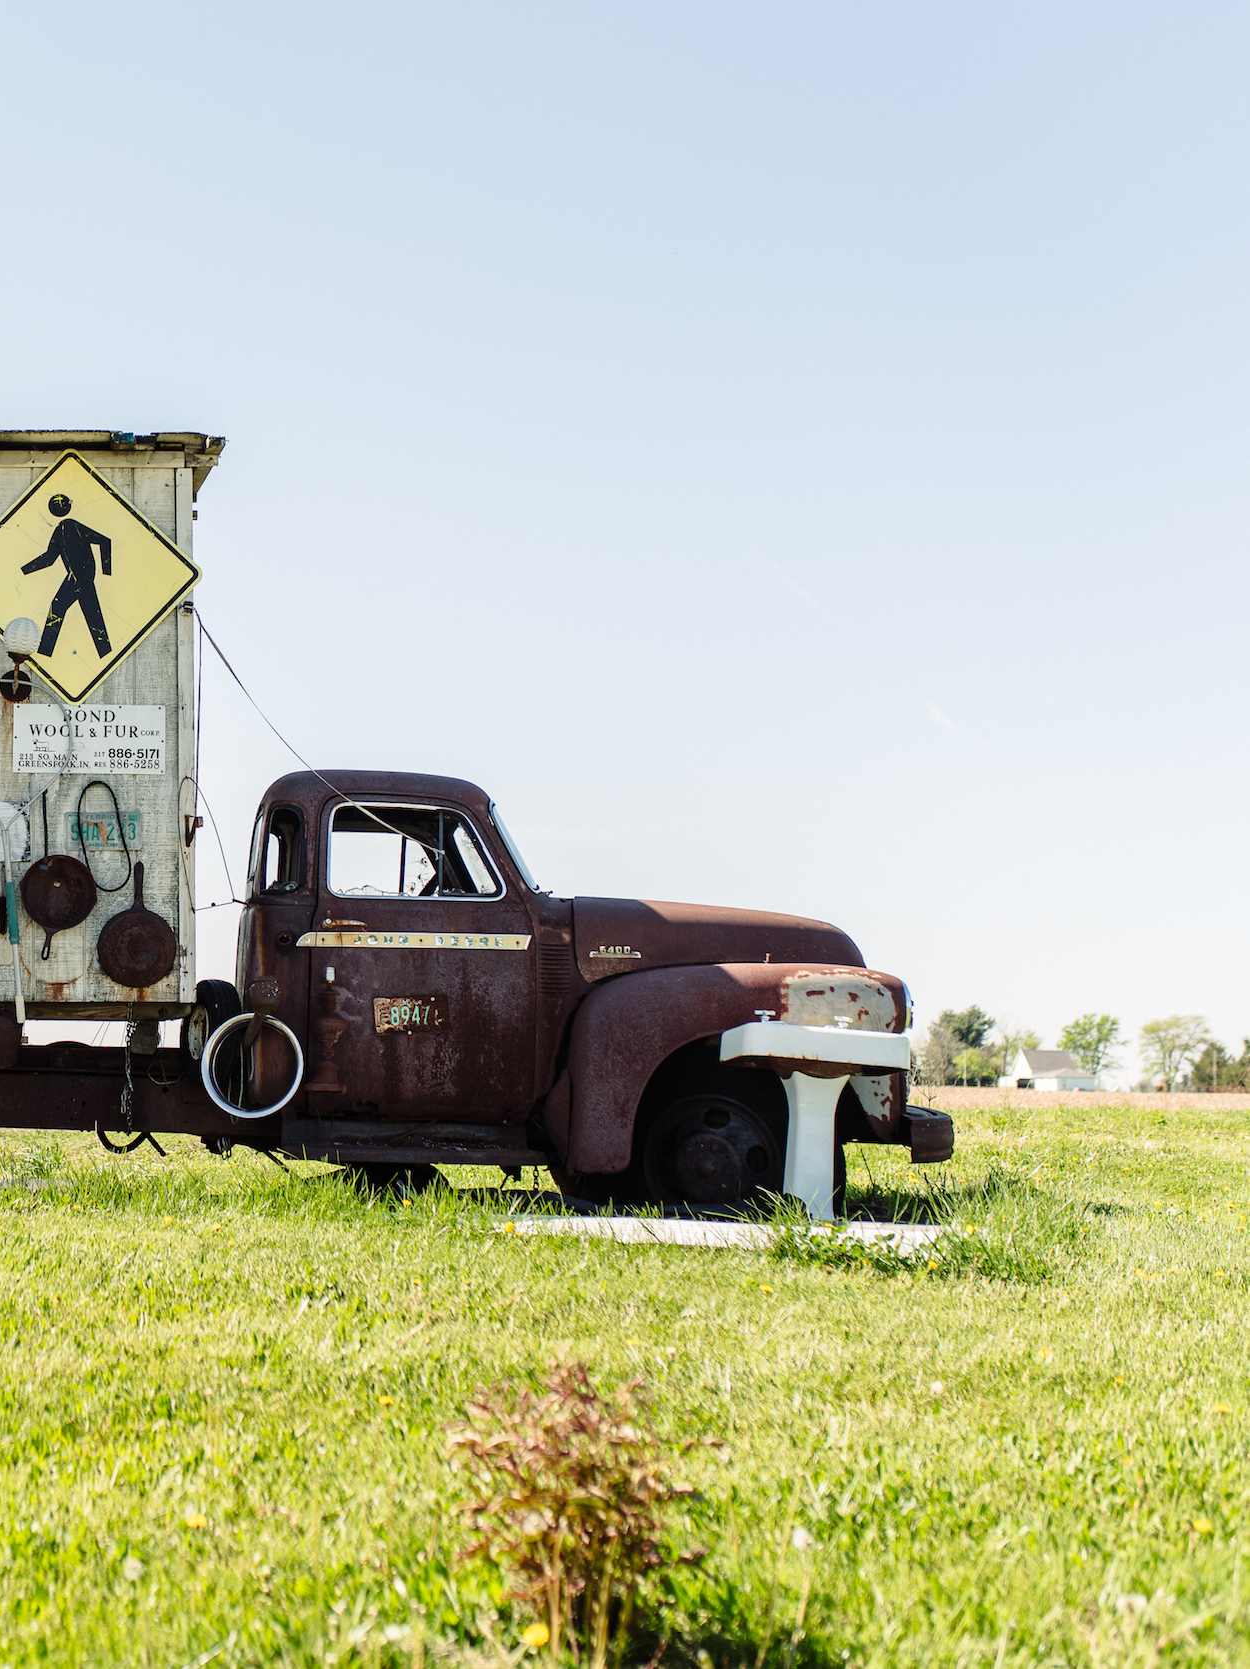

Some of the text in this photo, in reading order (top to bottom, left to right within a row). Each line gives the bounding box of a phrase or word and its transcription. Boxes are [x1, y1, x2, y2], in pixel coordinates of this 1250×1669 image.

[63, 708, 116, 723] BOND
[29, 723, 84, 738] WOOL
[89, 727, 97, 738] &
[103, 724, 139, 738] FUR
